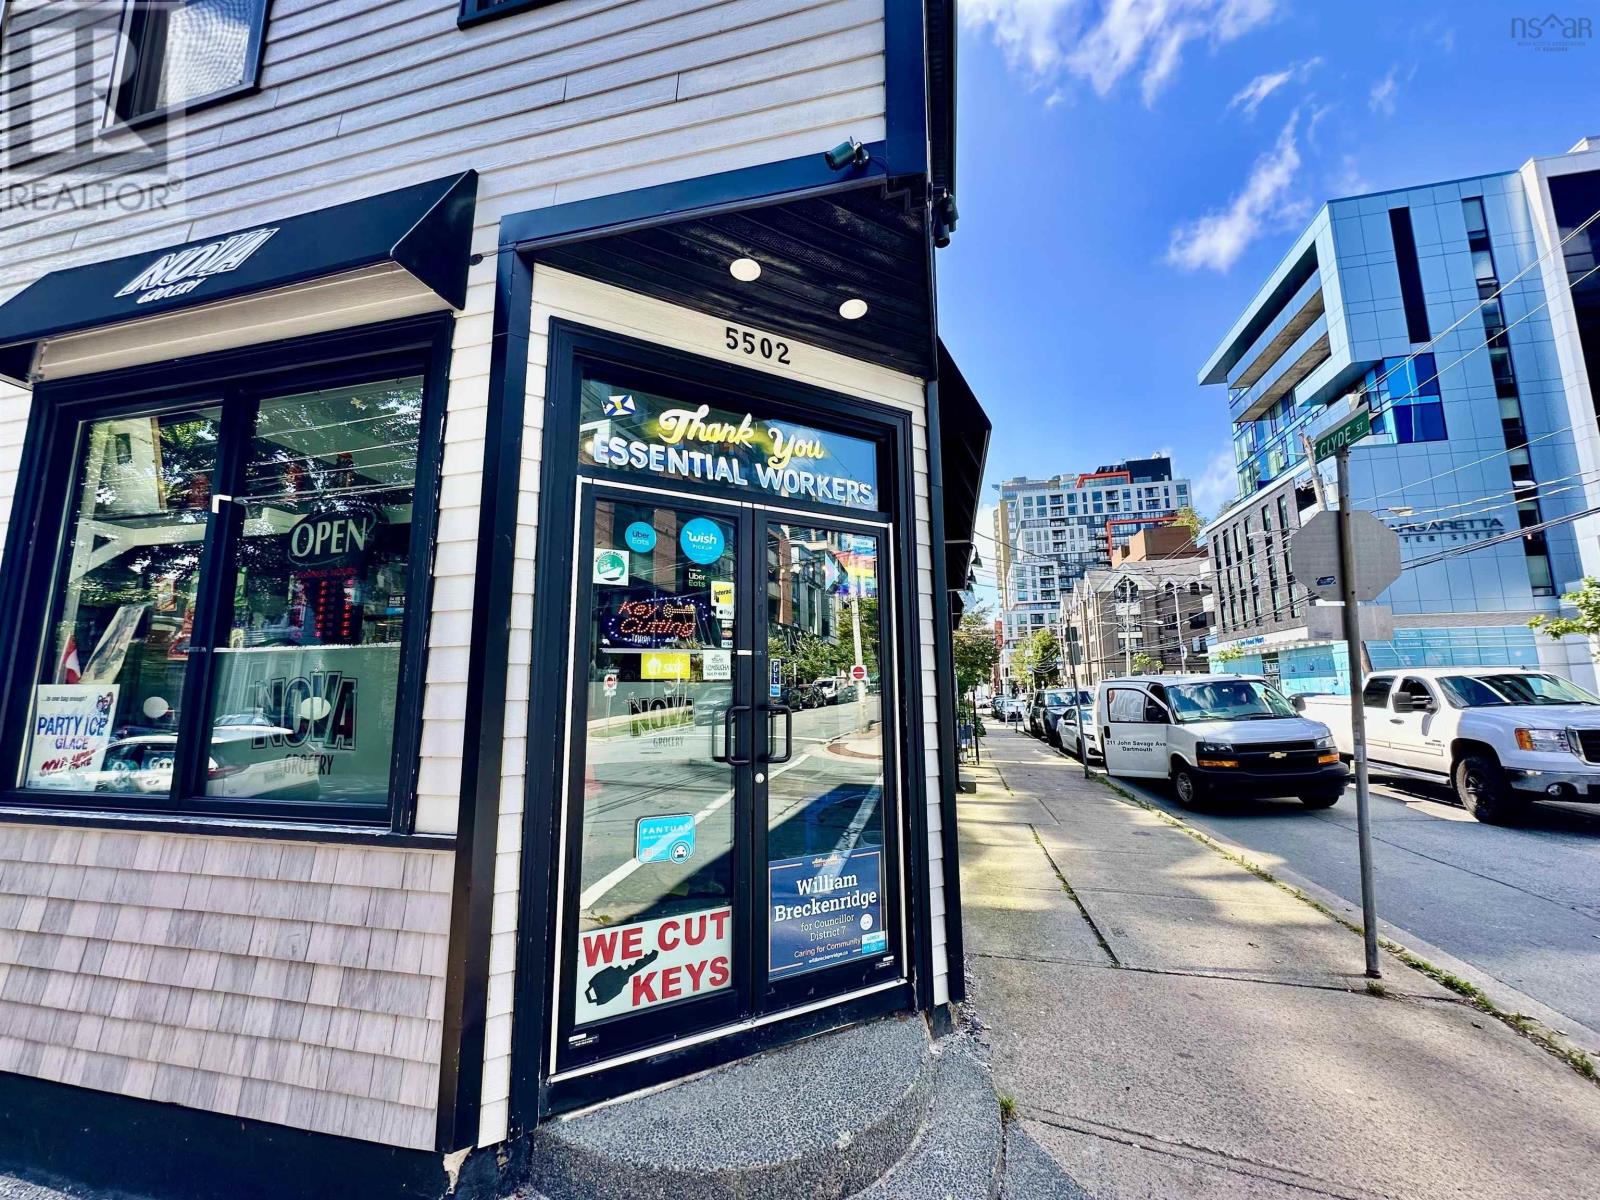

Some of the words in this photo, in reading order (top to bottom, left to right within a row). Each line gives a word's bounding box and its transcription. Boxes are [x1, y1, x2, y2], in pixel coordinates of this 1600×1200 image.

[114, 228, 280, 298] NOVA
[725, 326, 790, 365] 5502
[658, 404, 754, 449] Thank
[768, 427, 824, 470] You
[1320, 425, 1351, 457] CLYDE
[1356, 421, 1363, 433] ST
[592, 432, 748, 487] ESSENTIAL
[755, 462, 873, 505] WORKERS
[632, 530, 649, 538] Uber
[1388, 518, 1504, 534] ARGARETTA
[291, 517, 367, 557] OPEN
[632, 537, 649, 545] Eats
[687, 530, 718, 545] wish
[688, 572, 706, 580] Uber
[688, 579, 706, 588] Eats
[618, 601, 660, 619] Key
[620, 617, 697, 637] Cutting
[252, 671, 358, 750] NOVA
[629, 694, 695, 737] NOVA
[37, 715, 83, 736] PARTY
[84, 715, 108, 736] ICE
[55, 738, 88, 750] GLACE
[653, 736, 684, 747] GROCERY
[1132, 740, 1154, 748] Savage
[796, 873, 858, 896] William
[774, 890, 877, 922] Breckenridge
[801, 922, 812, 932] for
[815, 914, 855, 929] Councillor
[810, 927, 840, 942] District
[841, 925, 847, 935] 7
[583, 927, 644, 968] WE
[657, 910, 730, 952] CUT
[794, 947, 815, 958] Caring
[816, 945, 825, 954] for
[826, 937, 861, 951] Community
[632, 956, 730, 1007] KEYS
